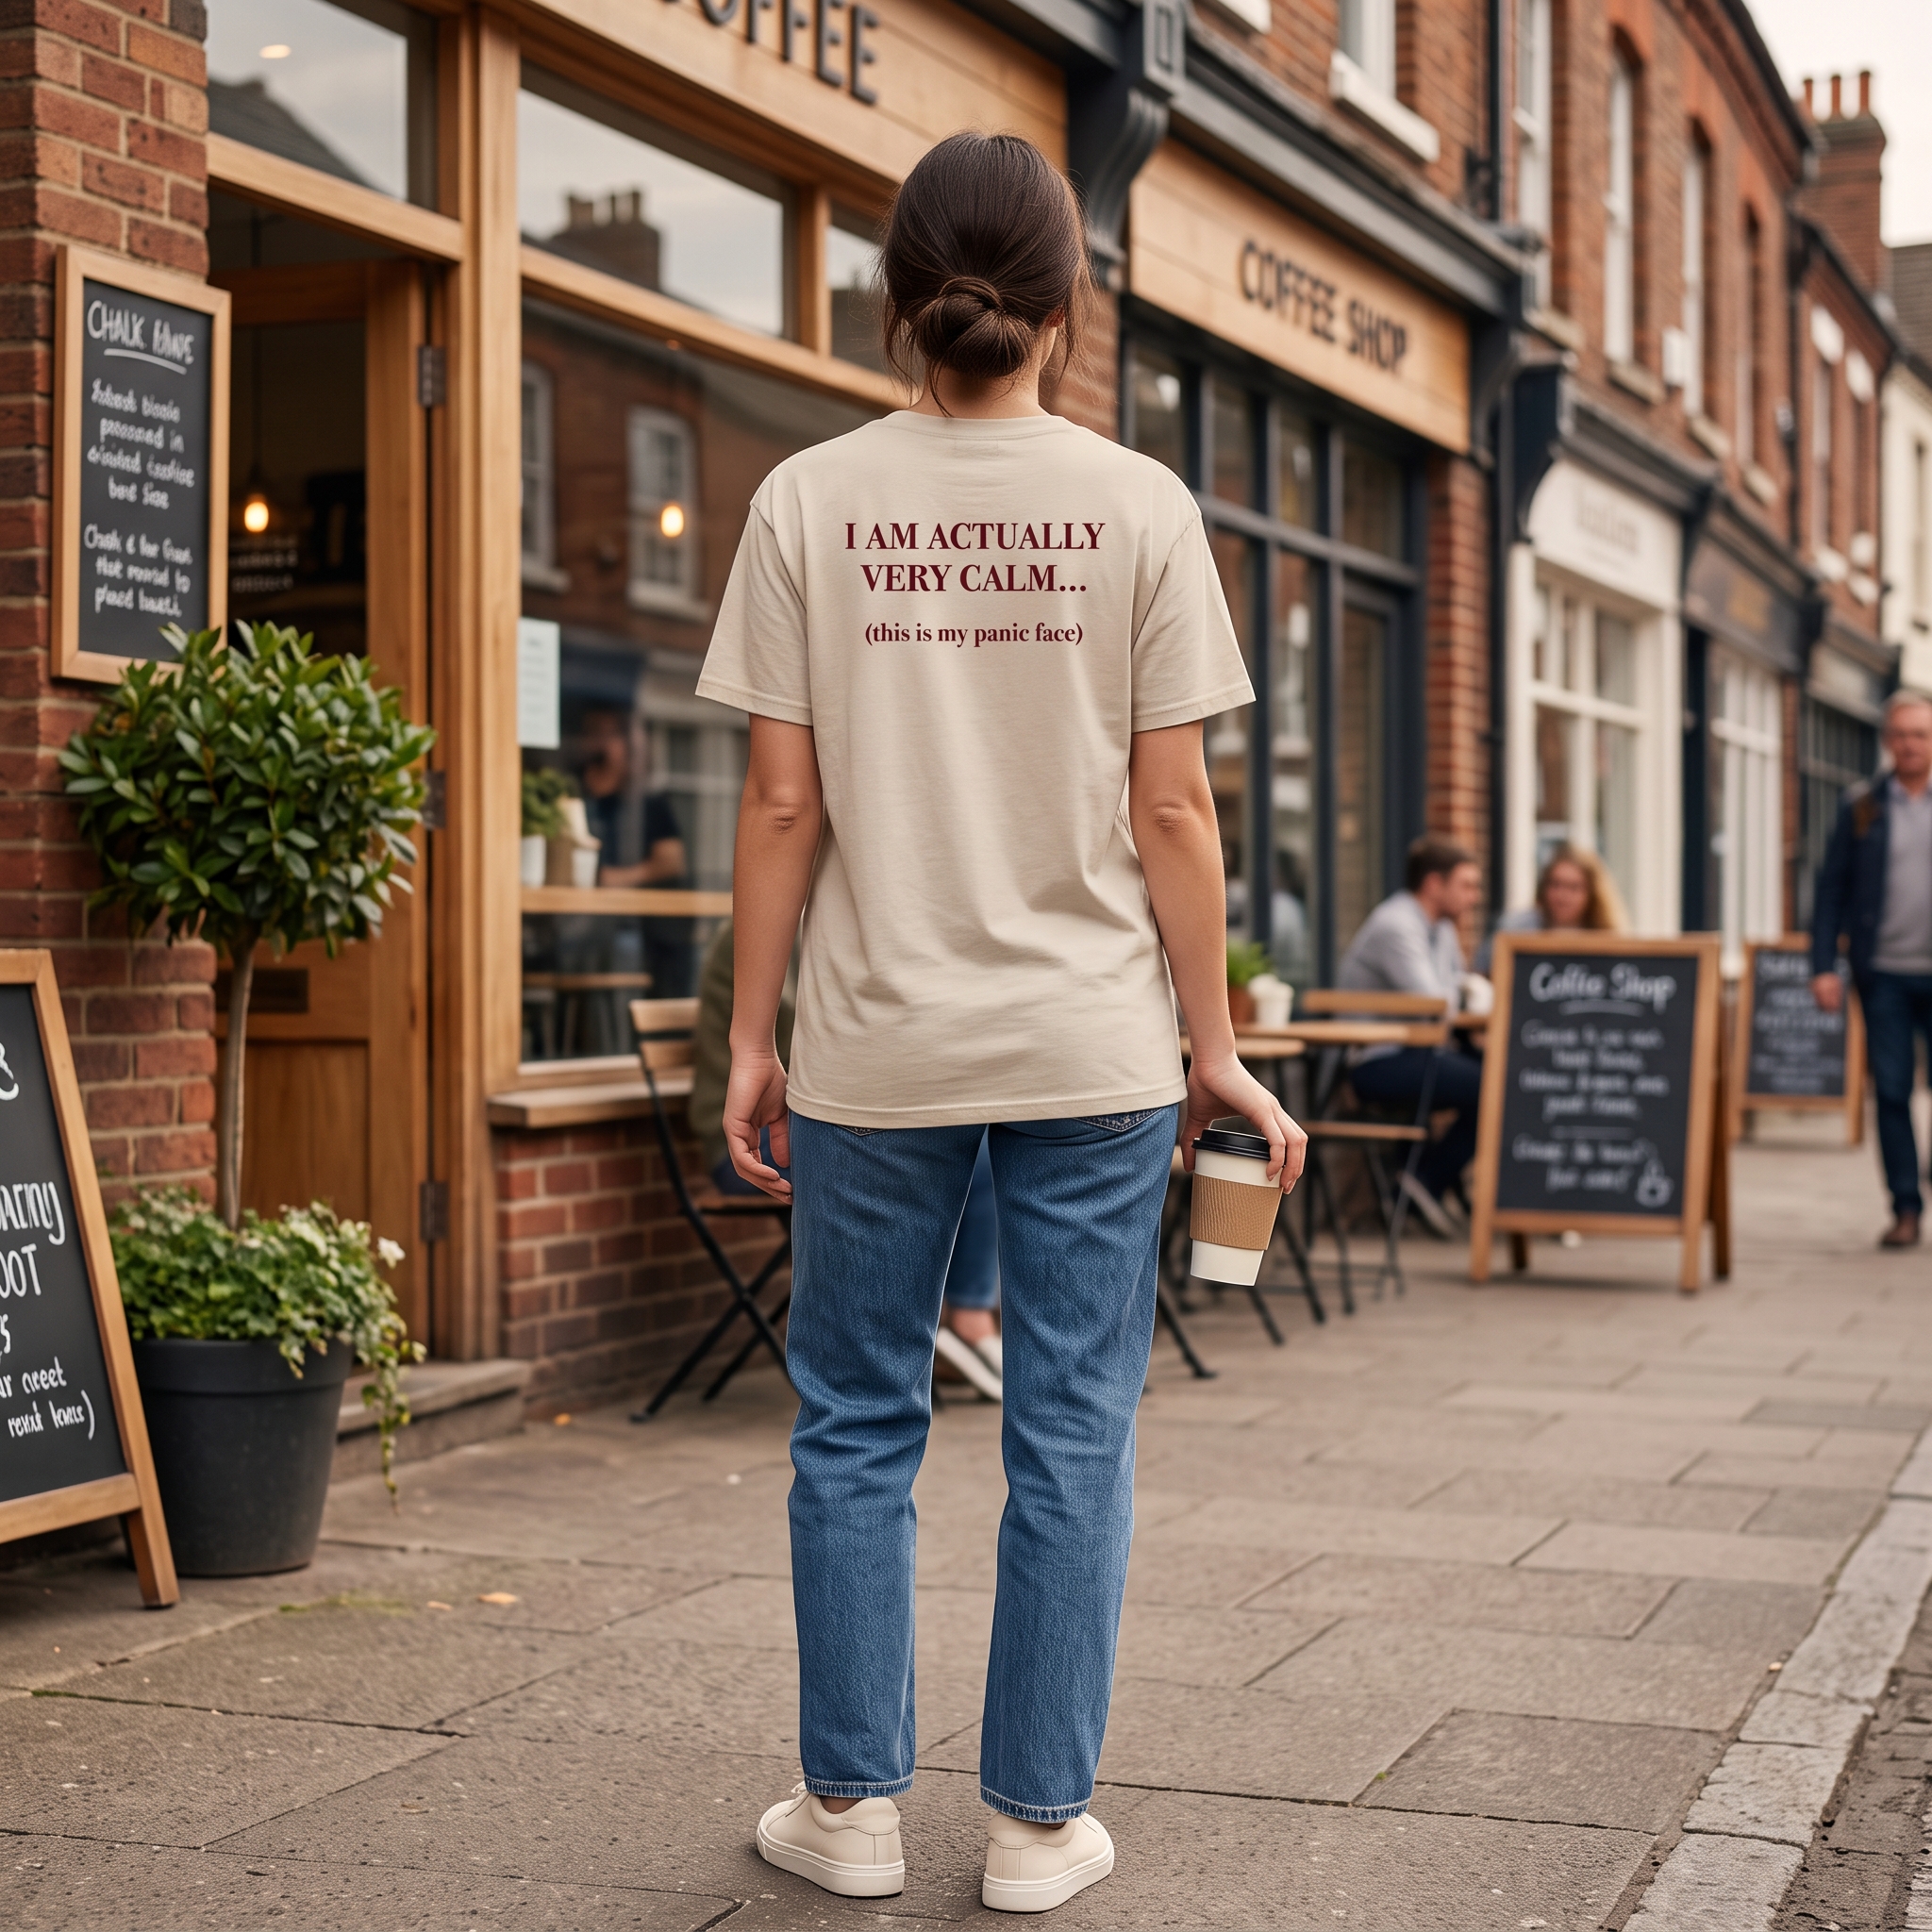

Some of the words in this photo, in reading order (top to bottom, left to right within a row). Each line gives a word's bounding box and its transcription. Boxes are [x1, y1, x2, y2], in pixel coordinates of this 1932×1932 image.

[660, 0, 877, 107] FEE
[1239, 239, 1337, 345] COFFEE
[1347, 298, 1407, 376] SHOP
[844, 523, 857, 550] I
[864, 523, 920, 550] AM
[926, 522, 1107, 550] ACTUALLY
[859, 564, 953, 592] VERY
[959, 564, 1087, 592] CALM...
[865, 622, 910, 646] (this
[915, 623, 932, 642] is
[938, 628, 969, 648] my
[974, 622, 1030, 648] panic
[1035, 622, 1083, 646] face)
